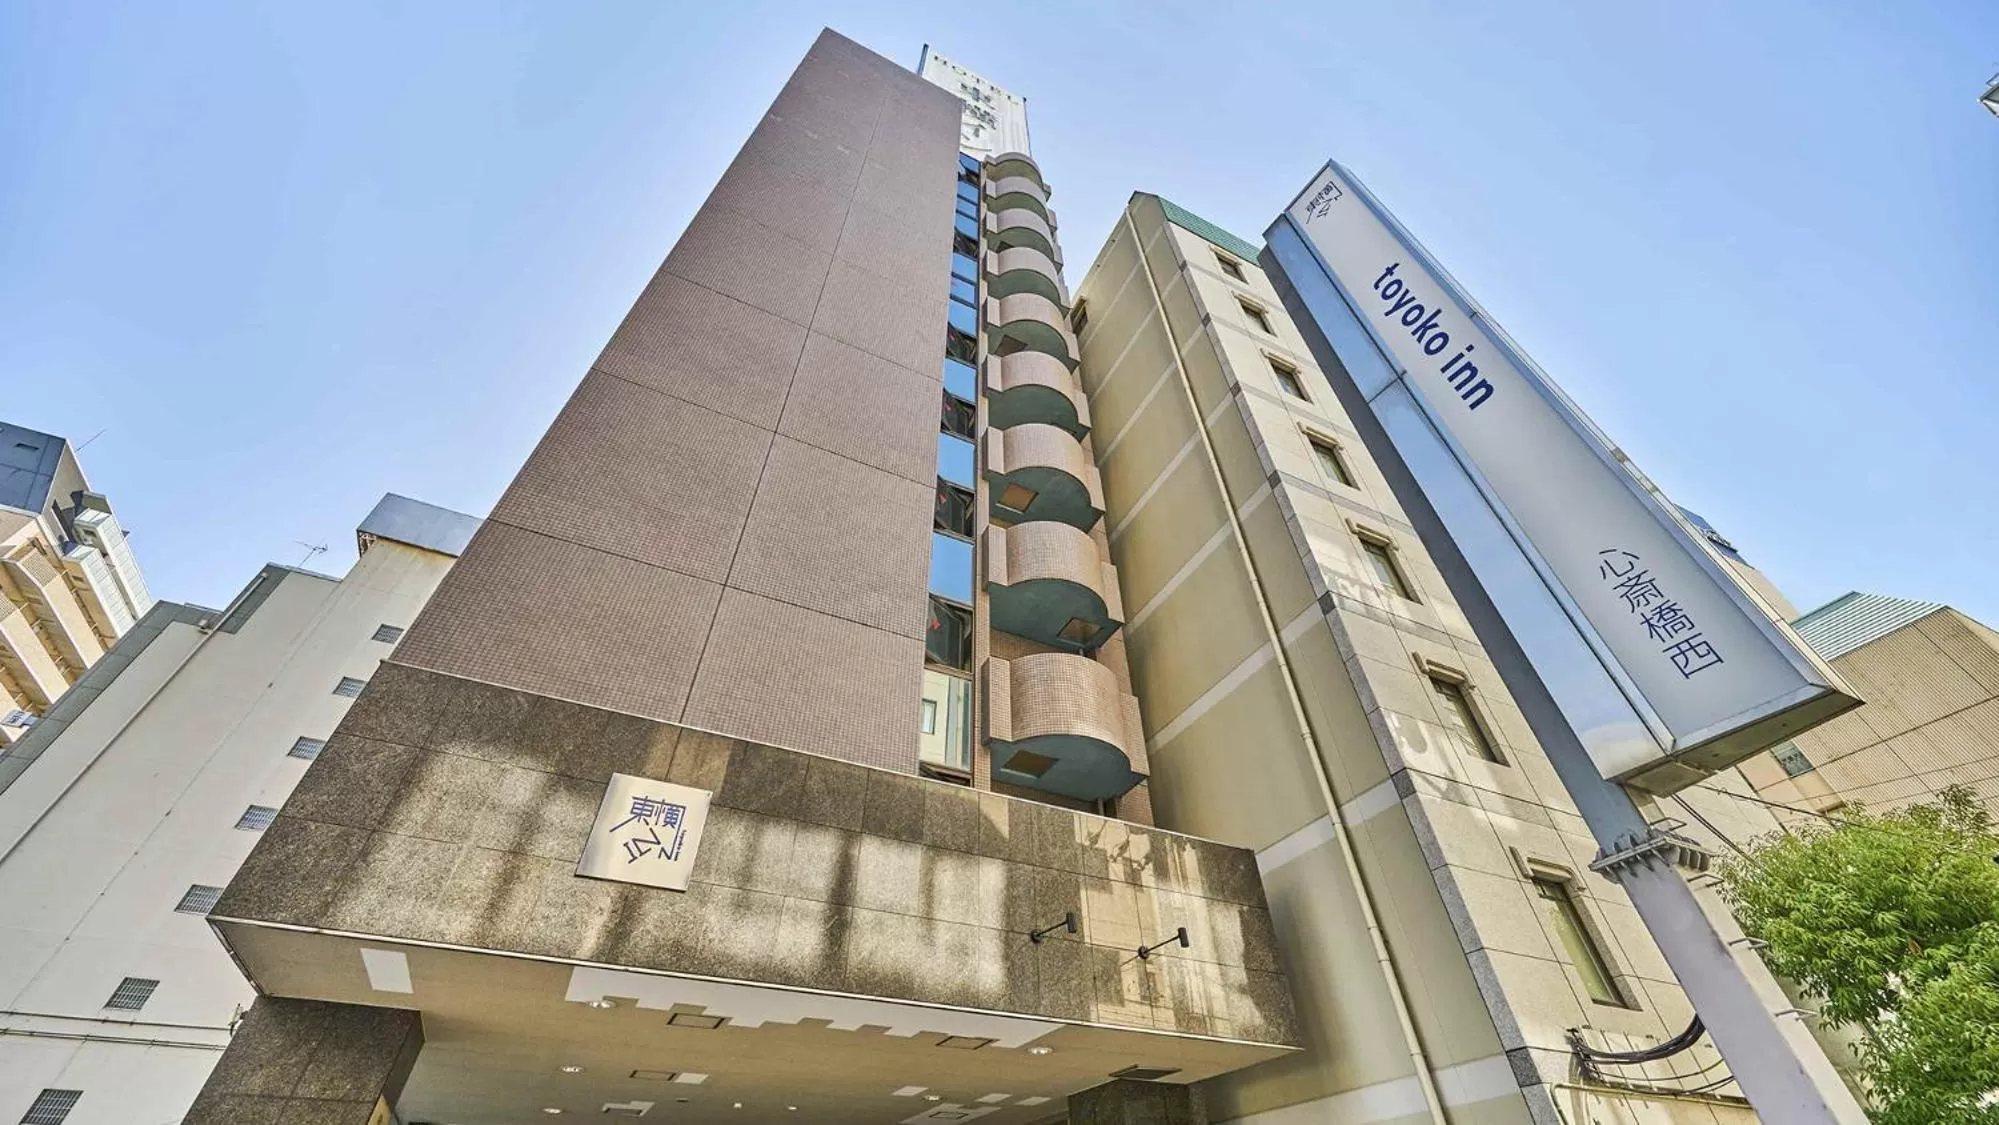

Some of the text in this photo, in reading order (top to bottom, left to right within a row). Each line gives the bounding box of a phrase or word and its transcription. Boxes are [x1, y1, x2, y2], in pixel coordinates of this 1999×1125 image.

[1373, 262, 1494, 411] toyoko inn
[1599, 549, 1724, 679] 心斎橋西
